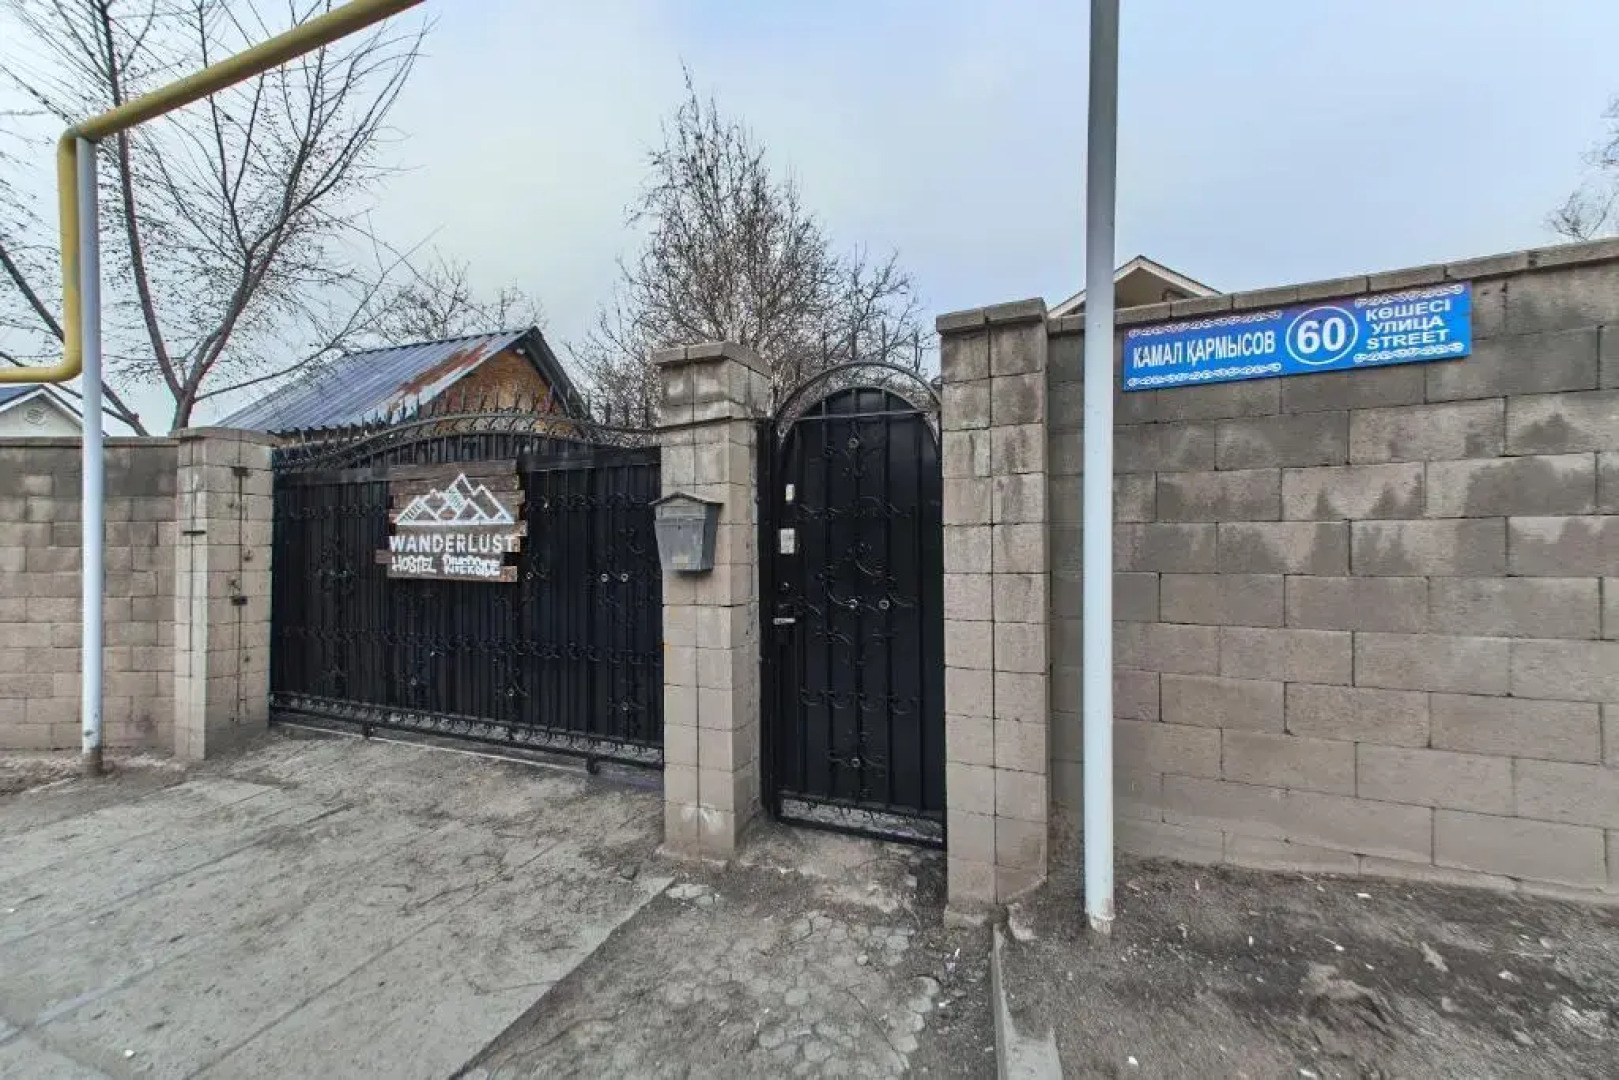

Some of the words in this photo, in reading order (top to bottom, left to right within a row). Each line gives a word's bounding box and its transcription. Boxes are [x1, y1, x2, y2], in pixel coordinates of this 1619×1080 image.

[1365, 299, 1451, 321] КӨШЕСІ
[1297, 317, 1346, 353] 60
[1371, 317, 1445, 336] УЛИЦА
[1133, 343, 1183, 369] КАМАЛ
[1187, 330, 1276, 366] ҚАРМЫСОВ
[1366, 329, 1450, 349] STREET
[389, 533, 514, 553] WANDERLUST
